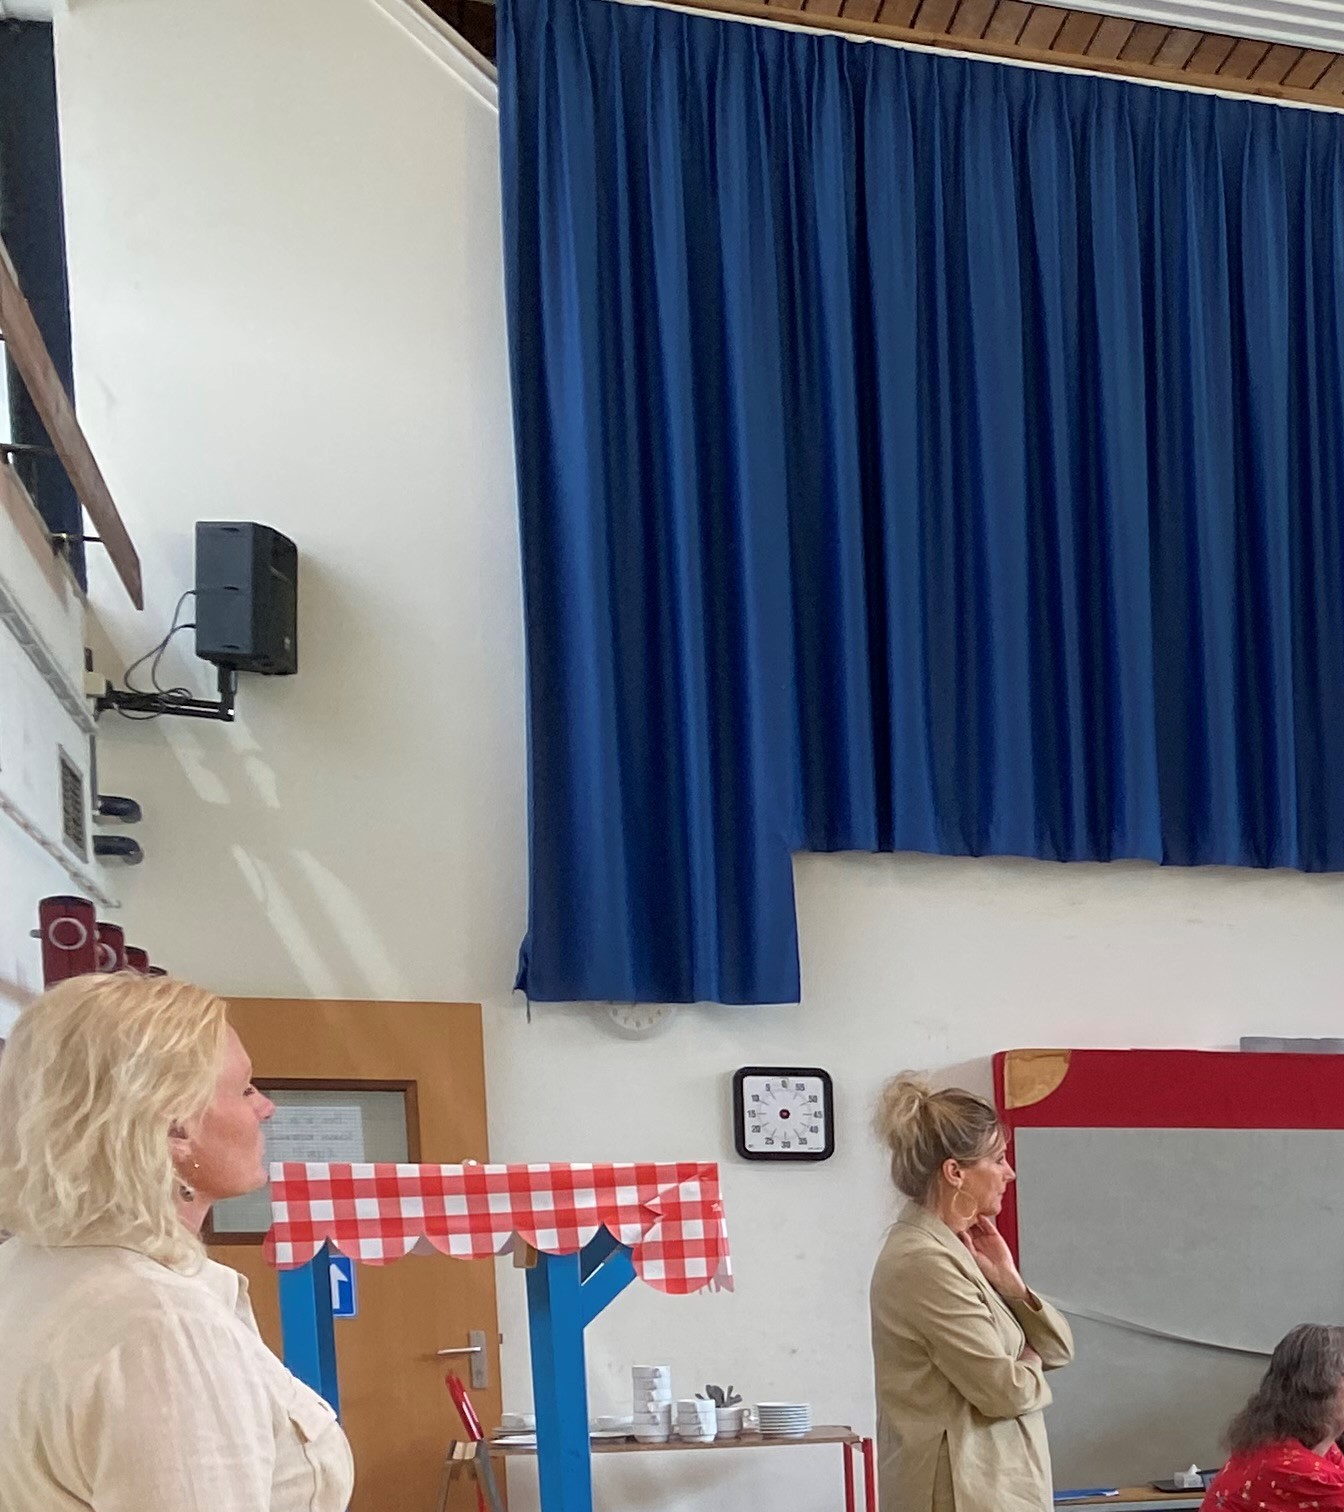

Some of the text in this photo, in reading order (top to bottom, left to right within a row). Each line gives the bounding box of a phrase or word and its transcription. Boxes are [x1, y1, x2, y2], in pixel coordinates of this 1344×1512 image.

[795, 1083, 805, 1091] 55
[808, 1095, 818, 1103] 50
[747, 1110, 756, 1118] 15
[813, 1111, 823, 1119] 45
[751, 1125, 761, 1133] 20
[809, 1126, 819, 1134] 40
[765, 1137, 774, 1145] 25
[781, 1141, 791, 1149] 30
[798, 1137, 808, 1145] 35
